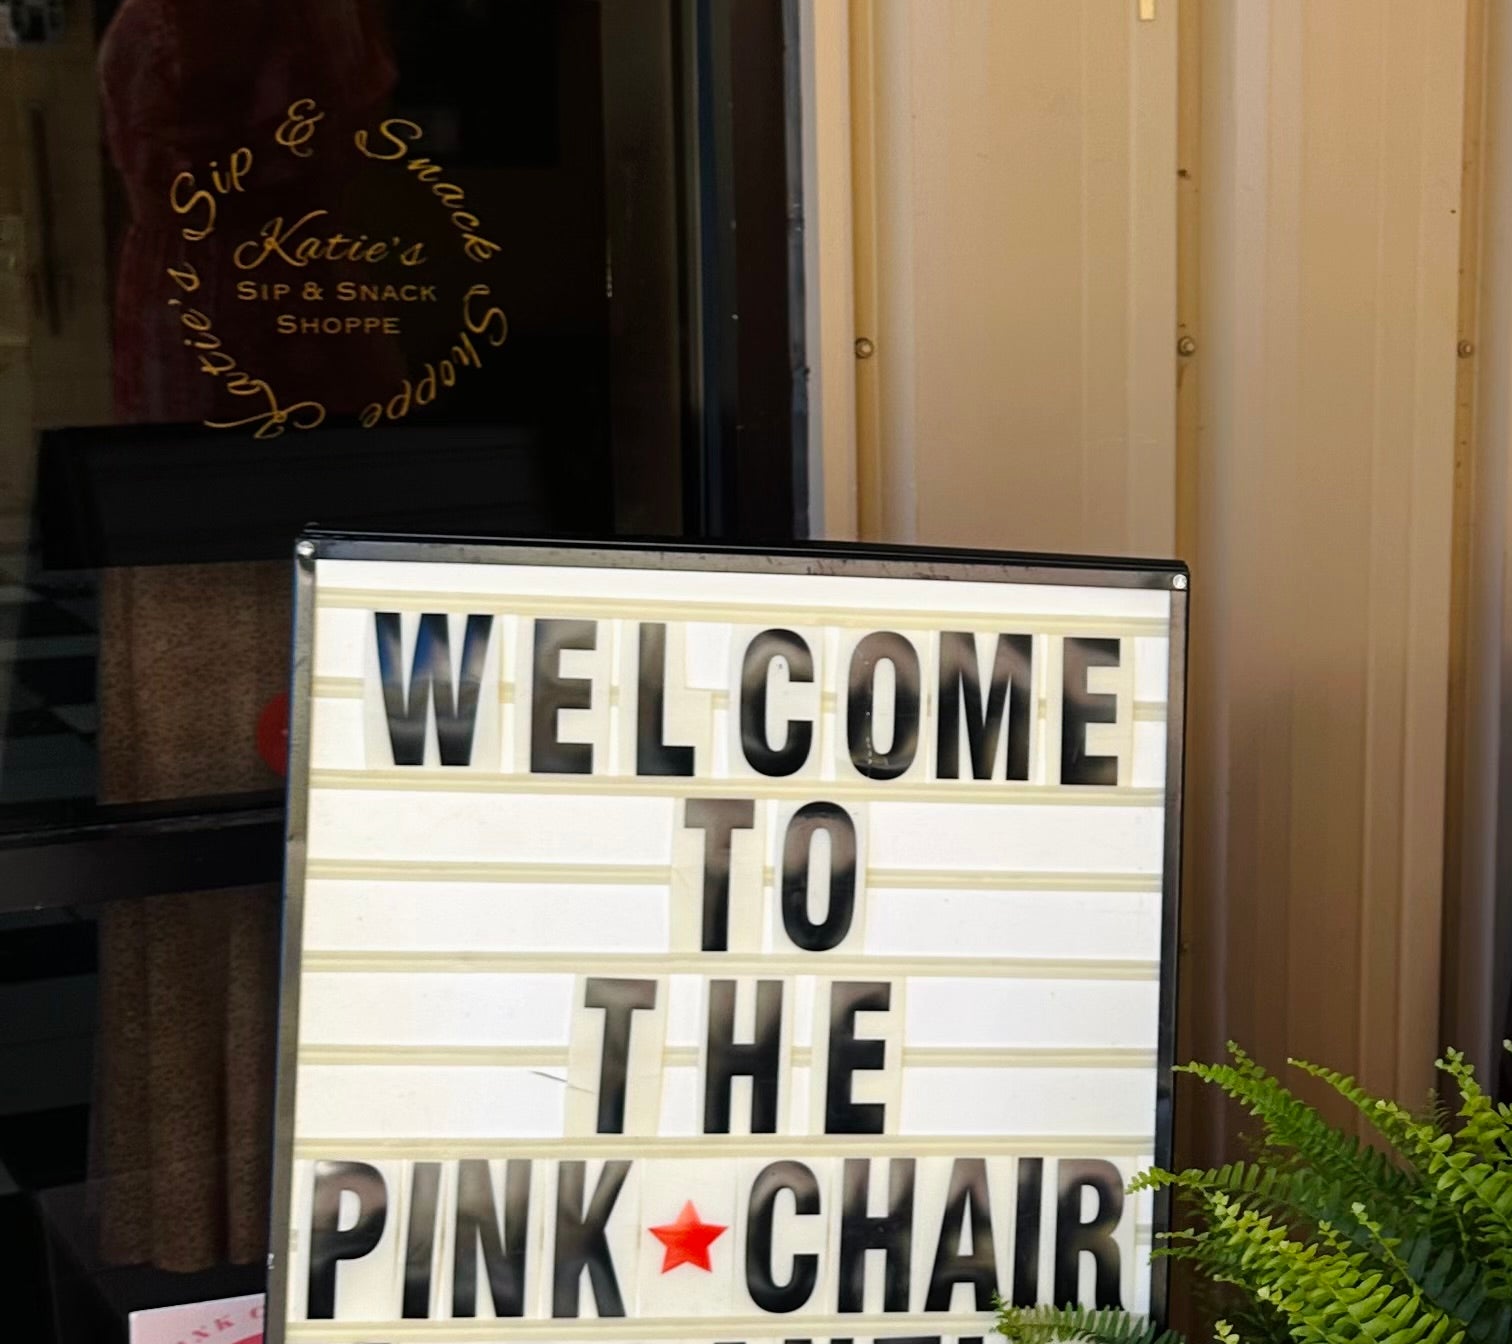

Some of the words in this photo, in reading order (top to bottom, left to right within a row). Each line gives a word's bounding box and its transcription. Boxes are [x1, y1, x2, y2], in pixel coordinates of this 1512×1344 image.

[170, 147, 253, 241] Sip
[275, 98, 325, 157] &
[354, 118, 502, 263] Snack
[234, 209, 427, 269] Katie's
[301, 281, 324, 301] &
[276, 314, 401, 335] SHOPPE
[359, 284, 509, 428] Shoppe
[373, 612, 1122, 788] WELCOME
[684, 798, 860, 954] TO
[585, 977, 892, 1136] THE
[306, 1158, 635, 1320] PINK
[745, 1157, 1126, 1315] CHAIR
